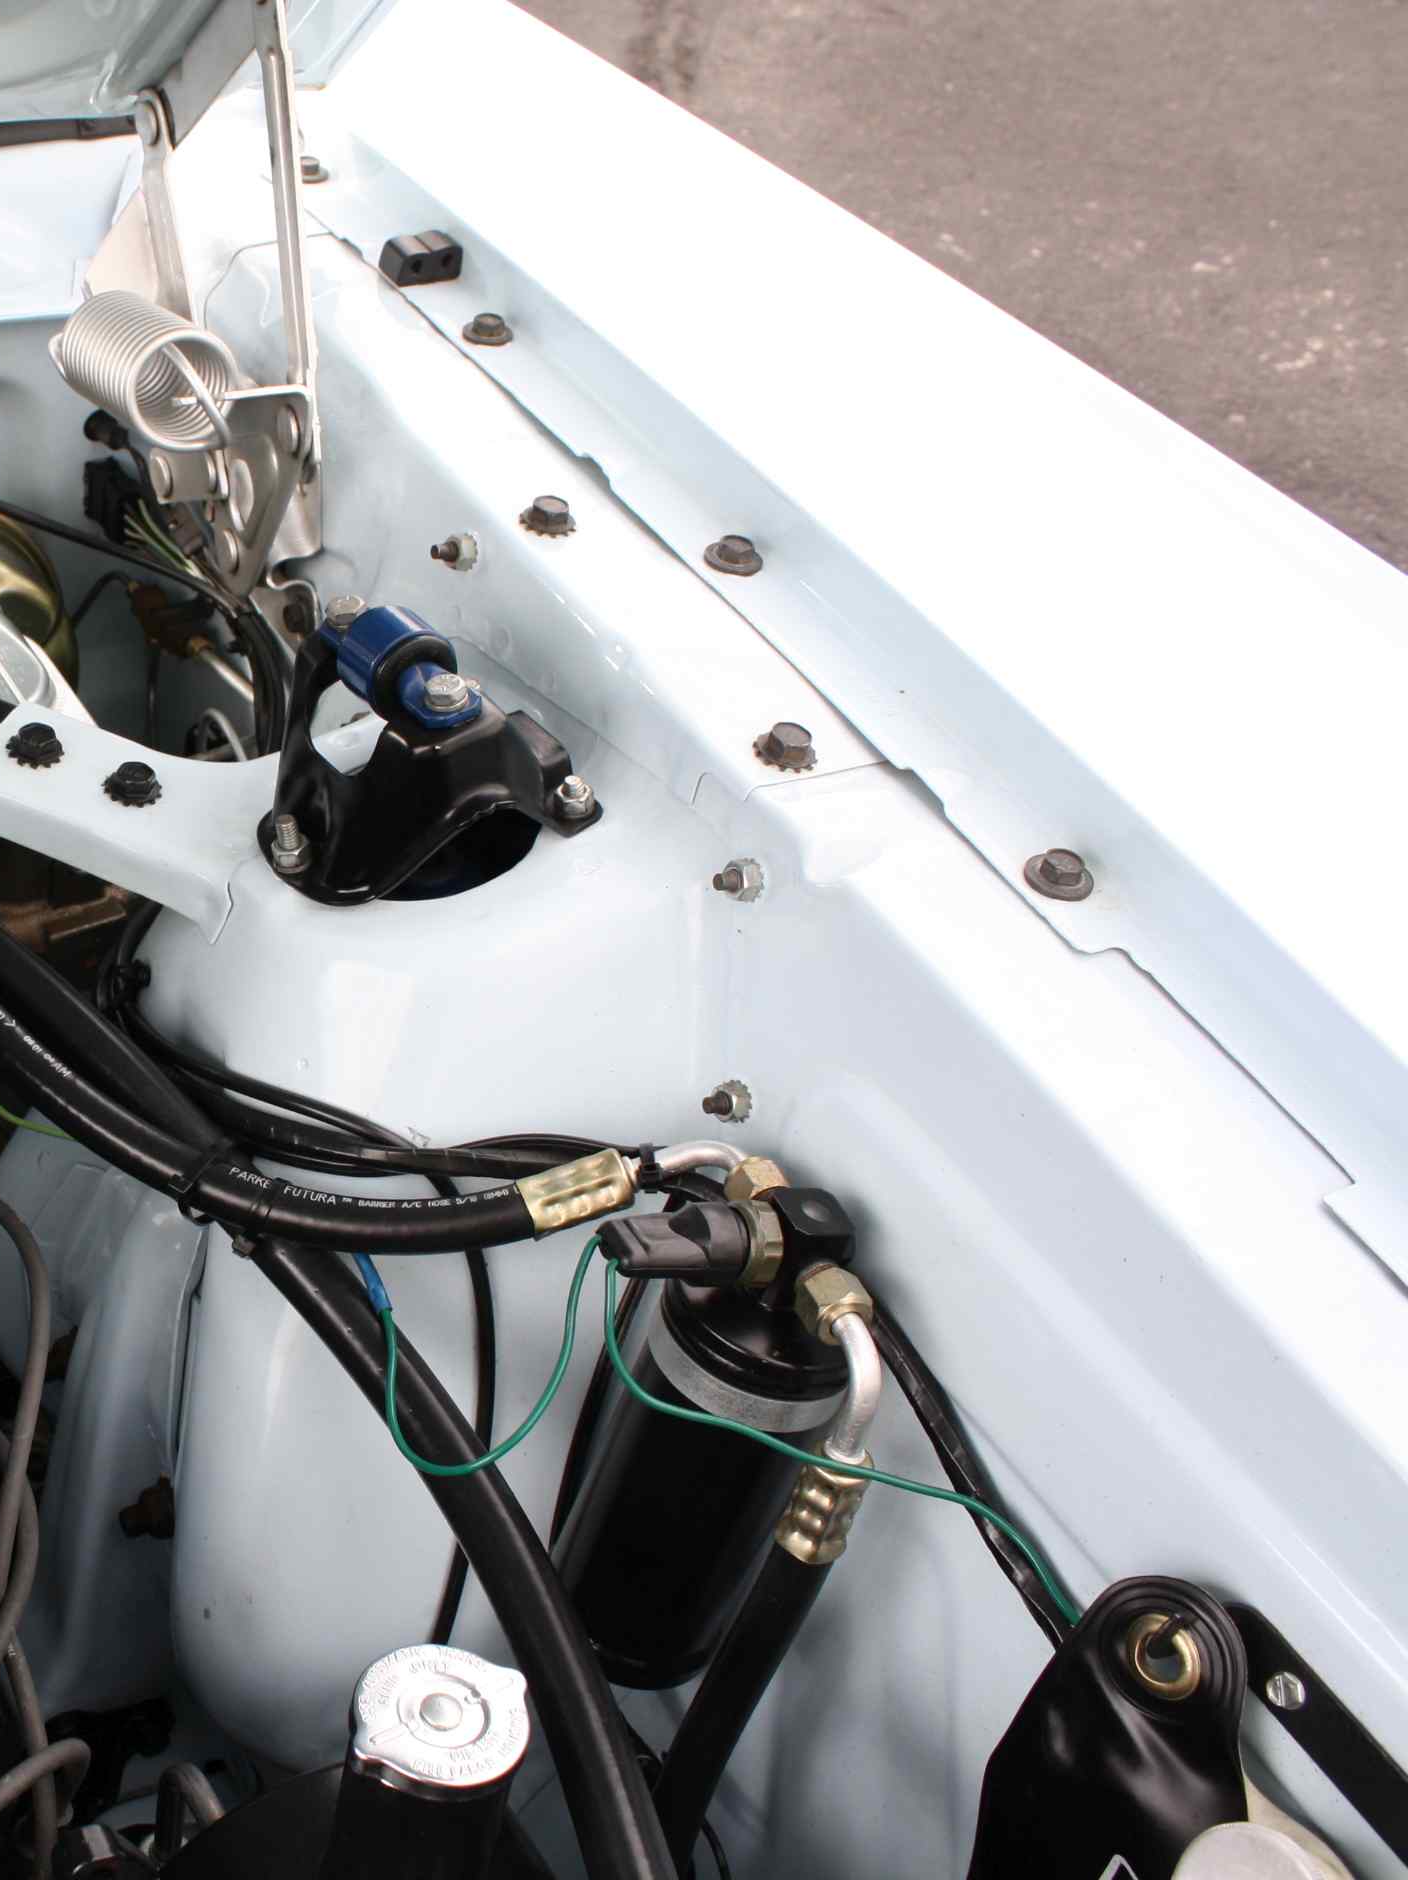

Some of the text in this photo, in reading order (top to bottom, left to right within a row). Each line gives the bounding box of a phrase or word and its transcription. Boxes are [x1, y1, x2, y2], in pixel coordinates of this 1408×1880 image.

[228, 1166, 272, 1190] PARKE
[283, 1184, 337, 1206] FUTURA
[400, 1198, 423, 1210] A/C
